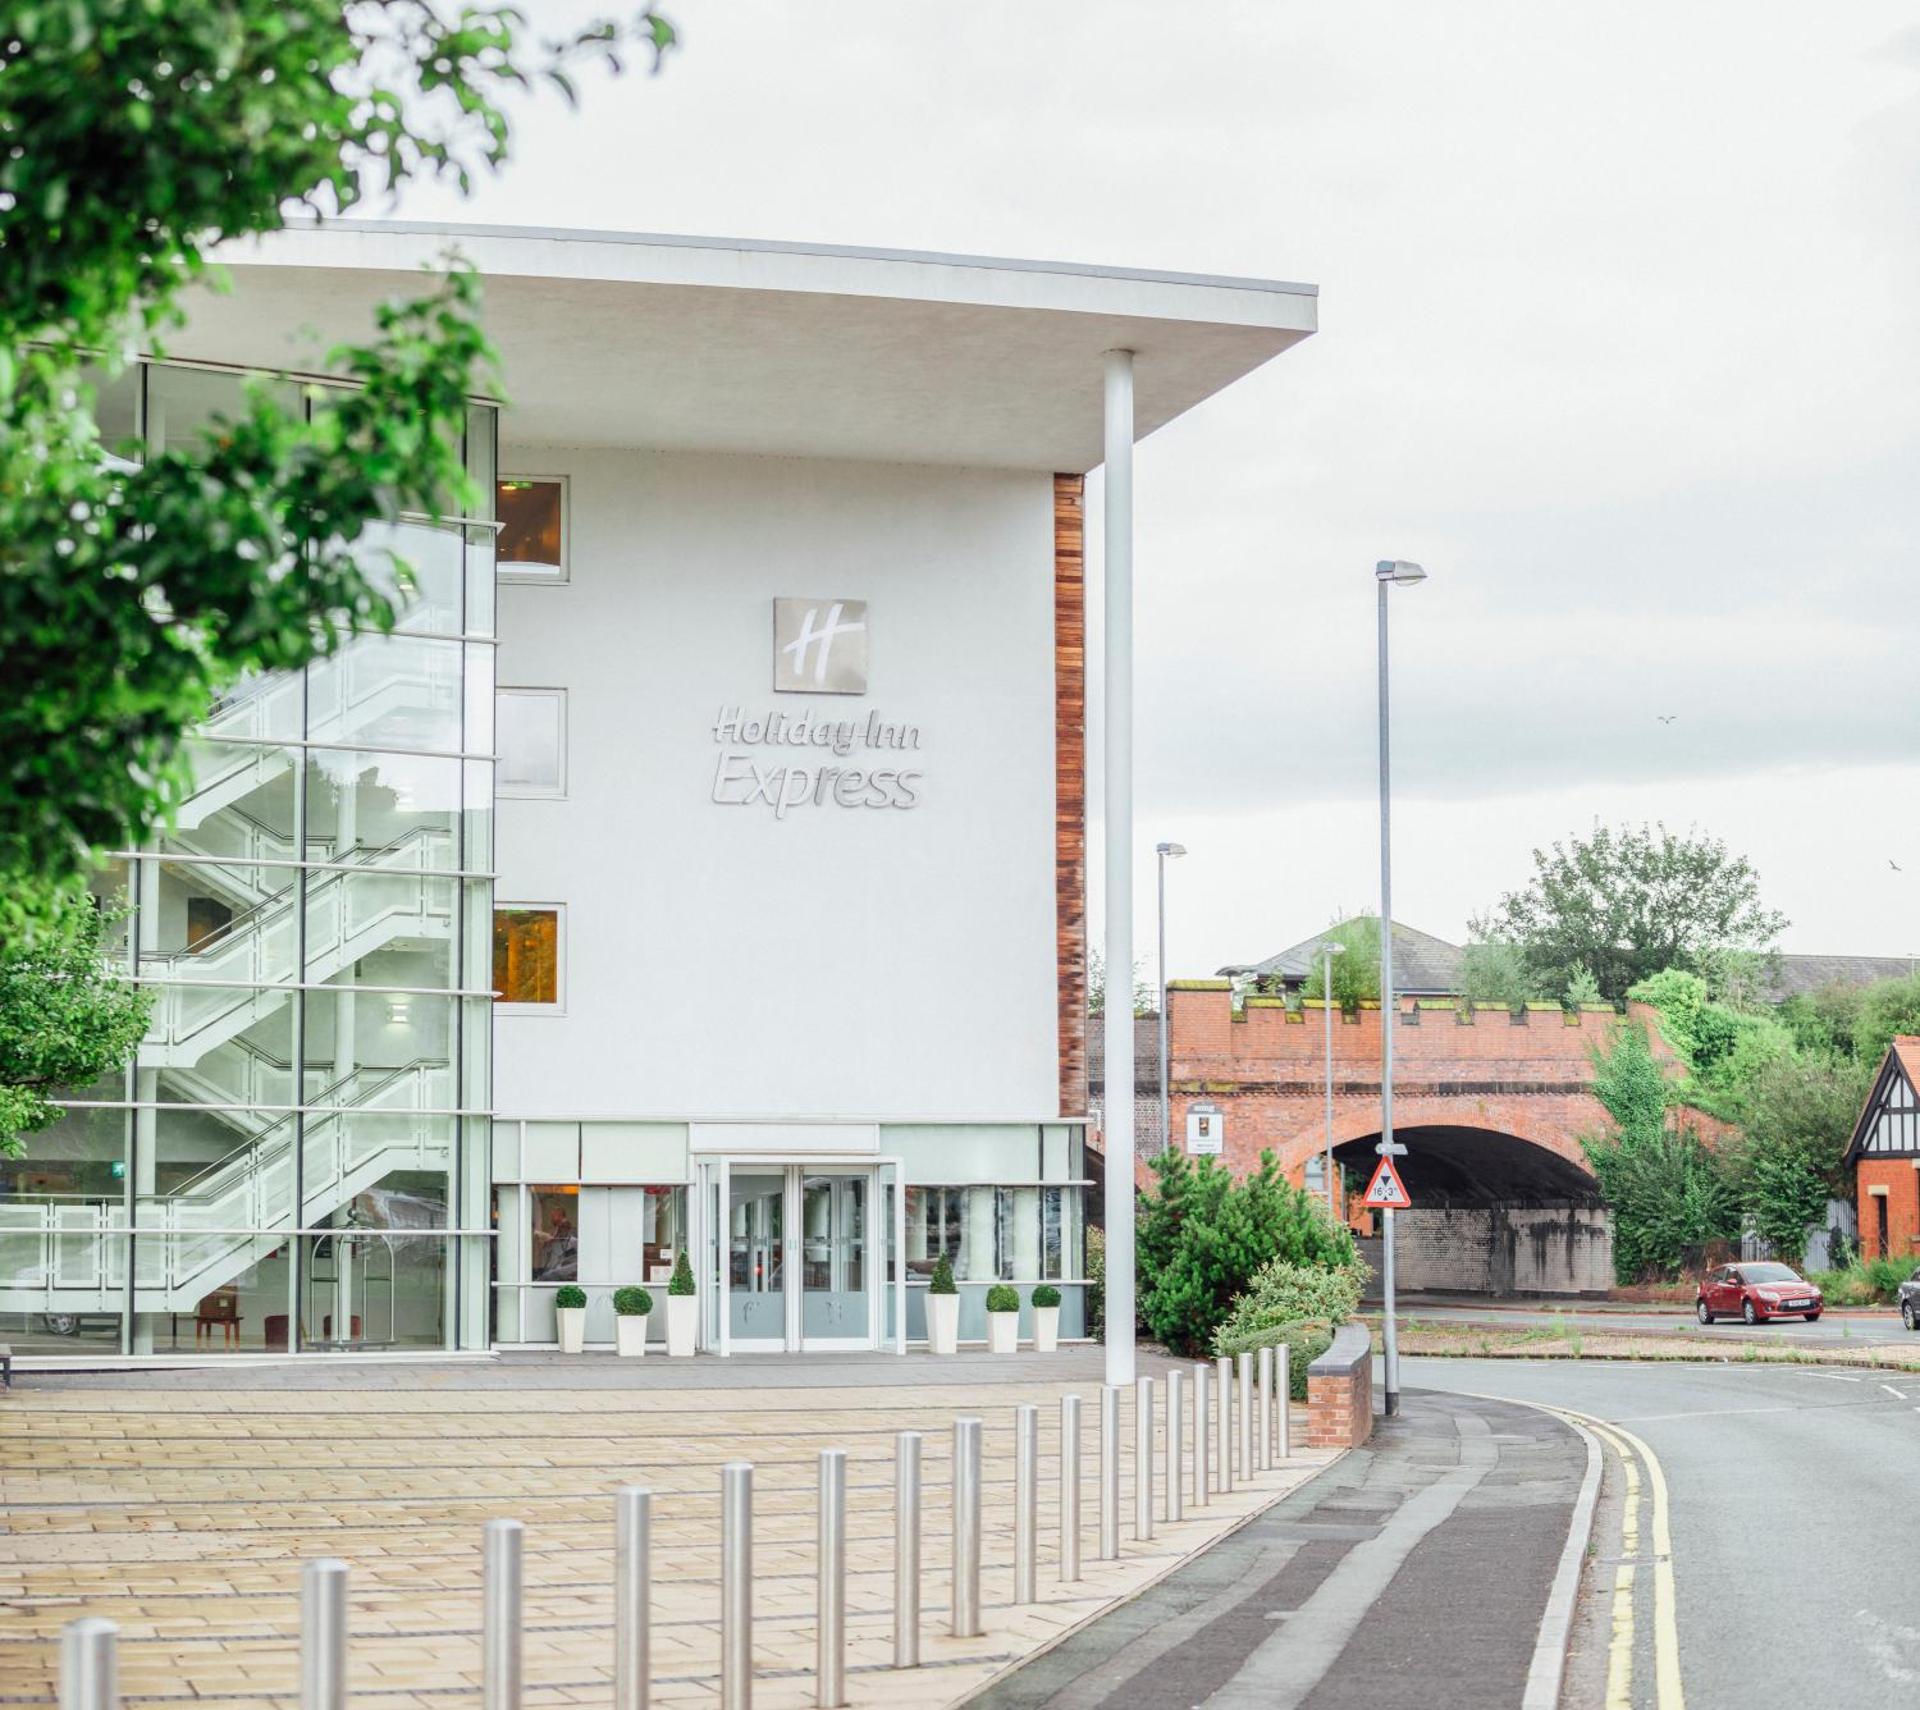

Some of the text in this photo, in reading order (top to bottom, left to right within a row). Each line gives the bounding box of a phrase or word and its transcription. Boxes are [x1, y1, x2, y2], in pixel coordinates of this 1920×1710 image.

[782, 603, 865, 683] H
[712, 705, 920, 756] Holiday Inn
[712, 750, 923, 819] Express
